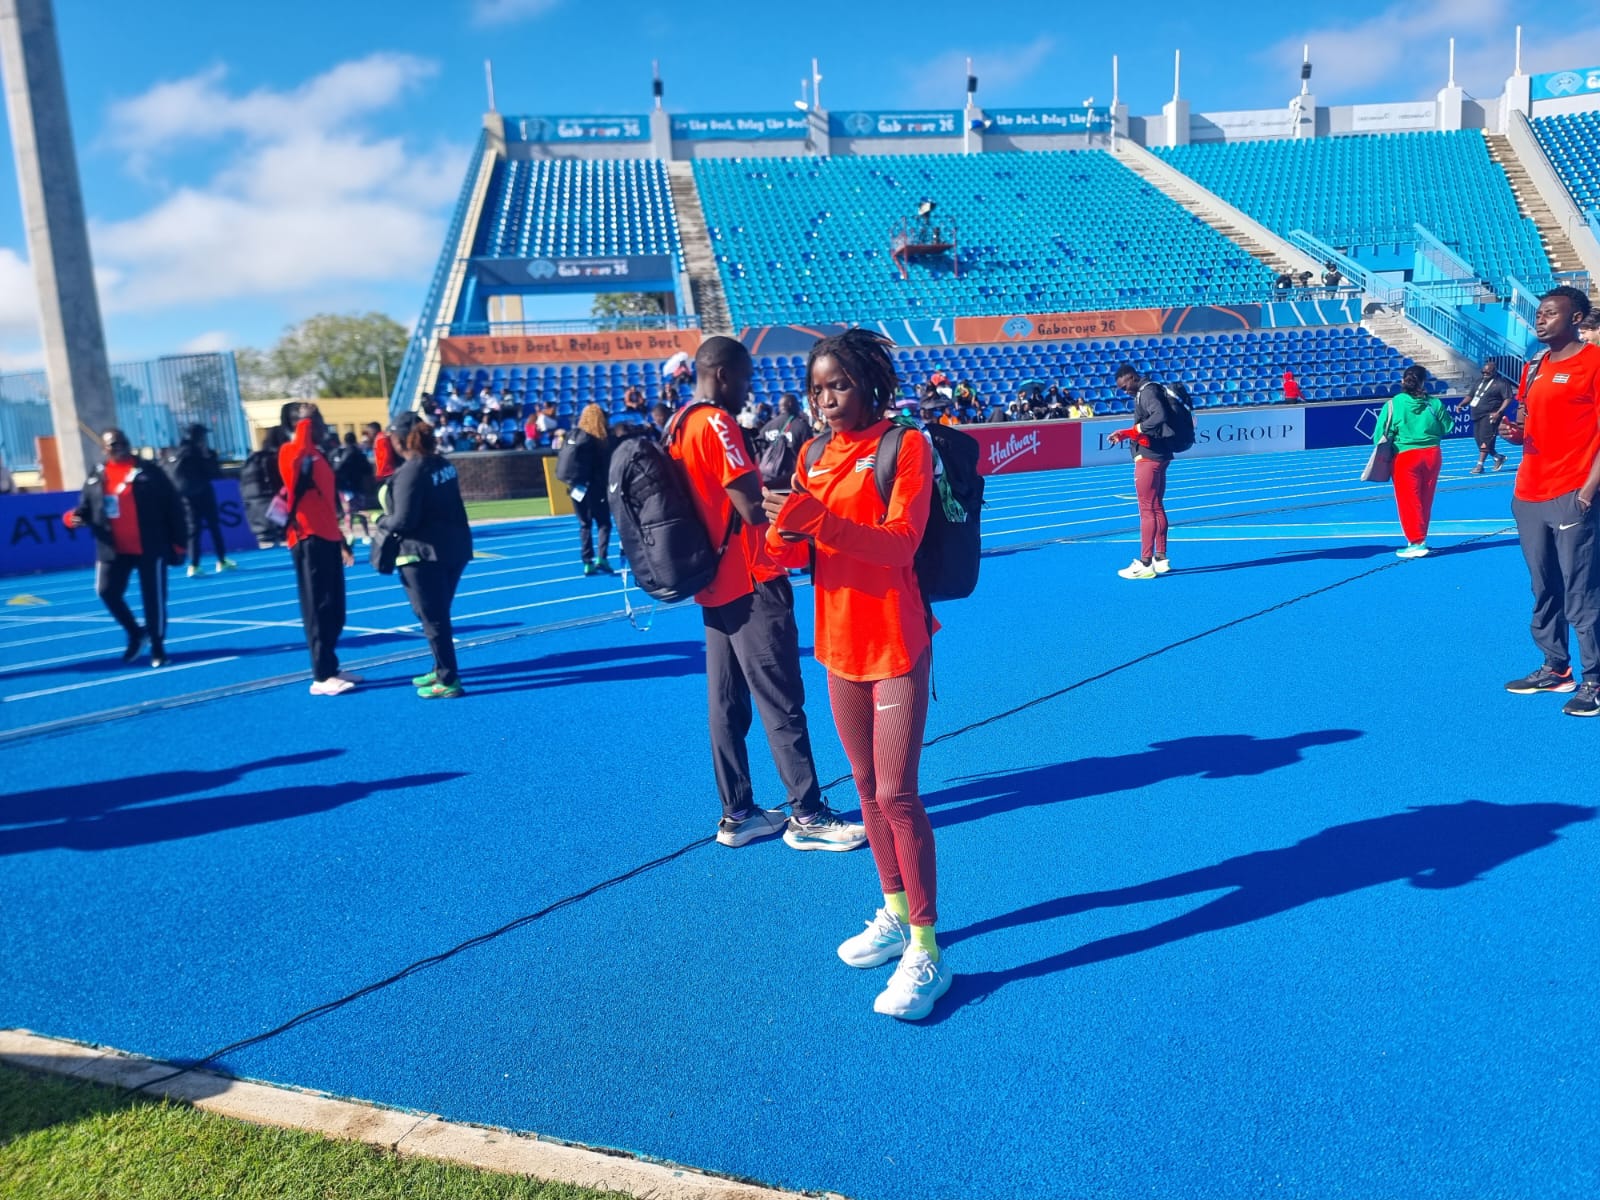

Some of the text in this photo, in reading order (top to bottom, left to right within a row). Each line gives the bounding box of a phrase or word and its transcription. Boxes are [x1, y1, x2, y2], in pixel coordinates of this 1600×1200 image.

[1037, 322, 1097, 336] Gaborone
[1101, 319, 1117, 333] 26
[492, 340, 519, 354] the
[569, 338, 610, 355] Relay
[616, 336, 642, 350] the
[648, 335, 681, 349] Best
[707, 413, 745, 470] KEN
[1216, 424, 1294, 442] GROUP
[988, 430, 1040, 464] Halfway
